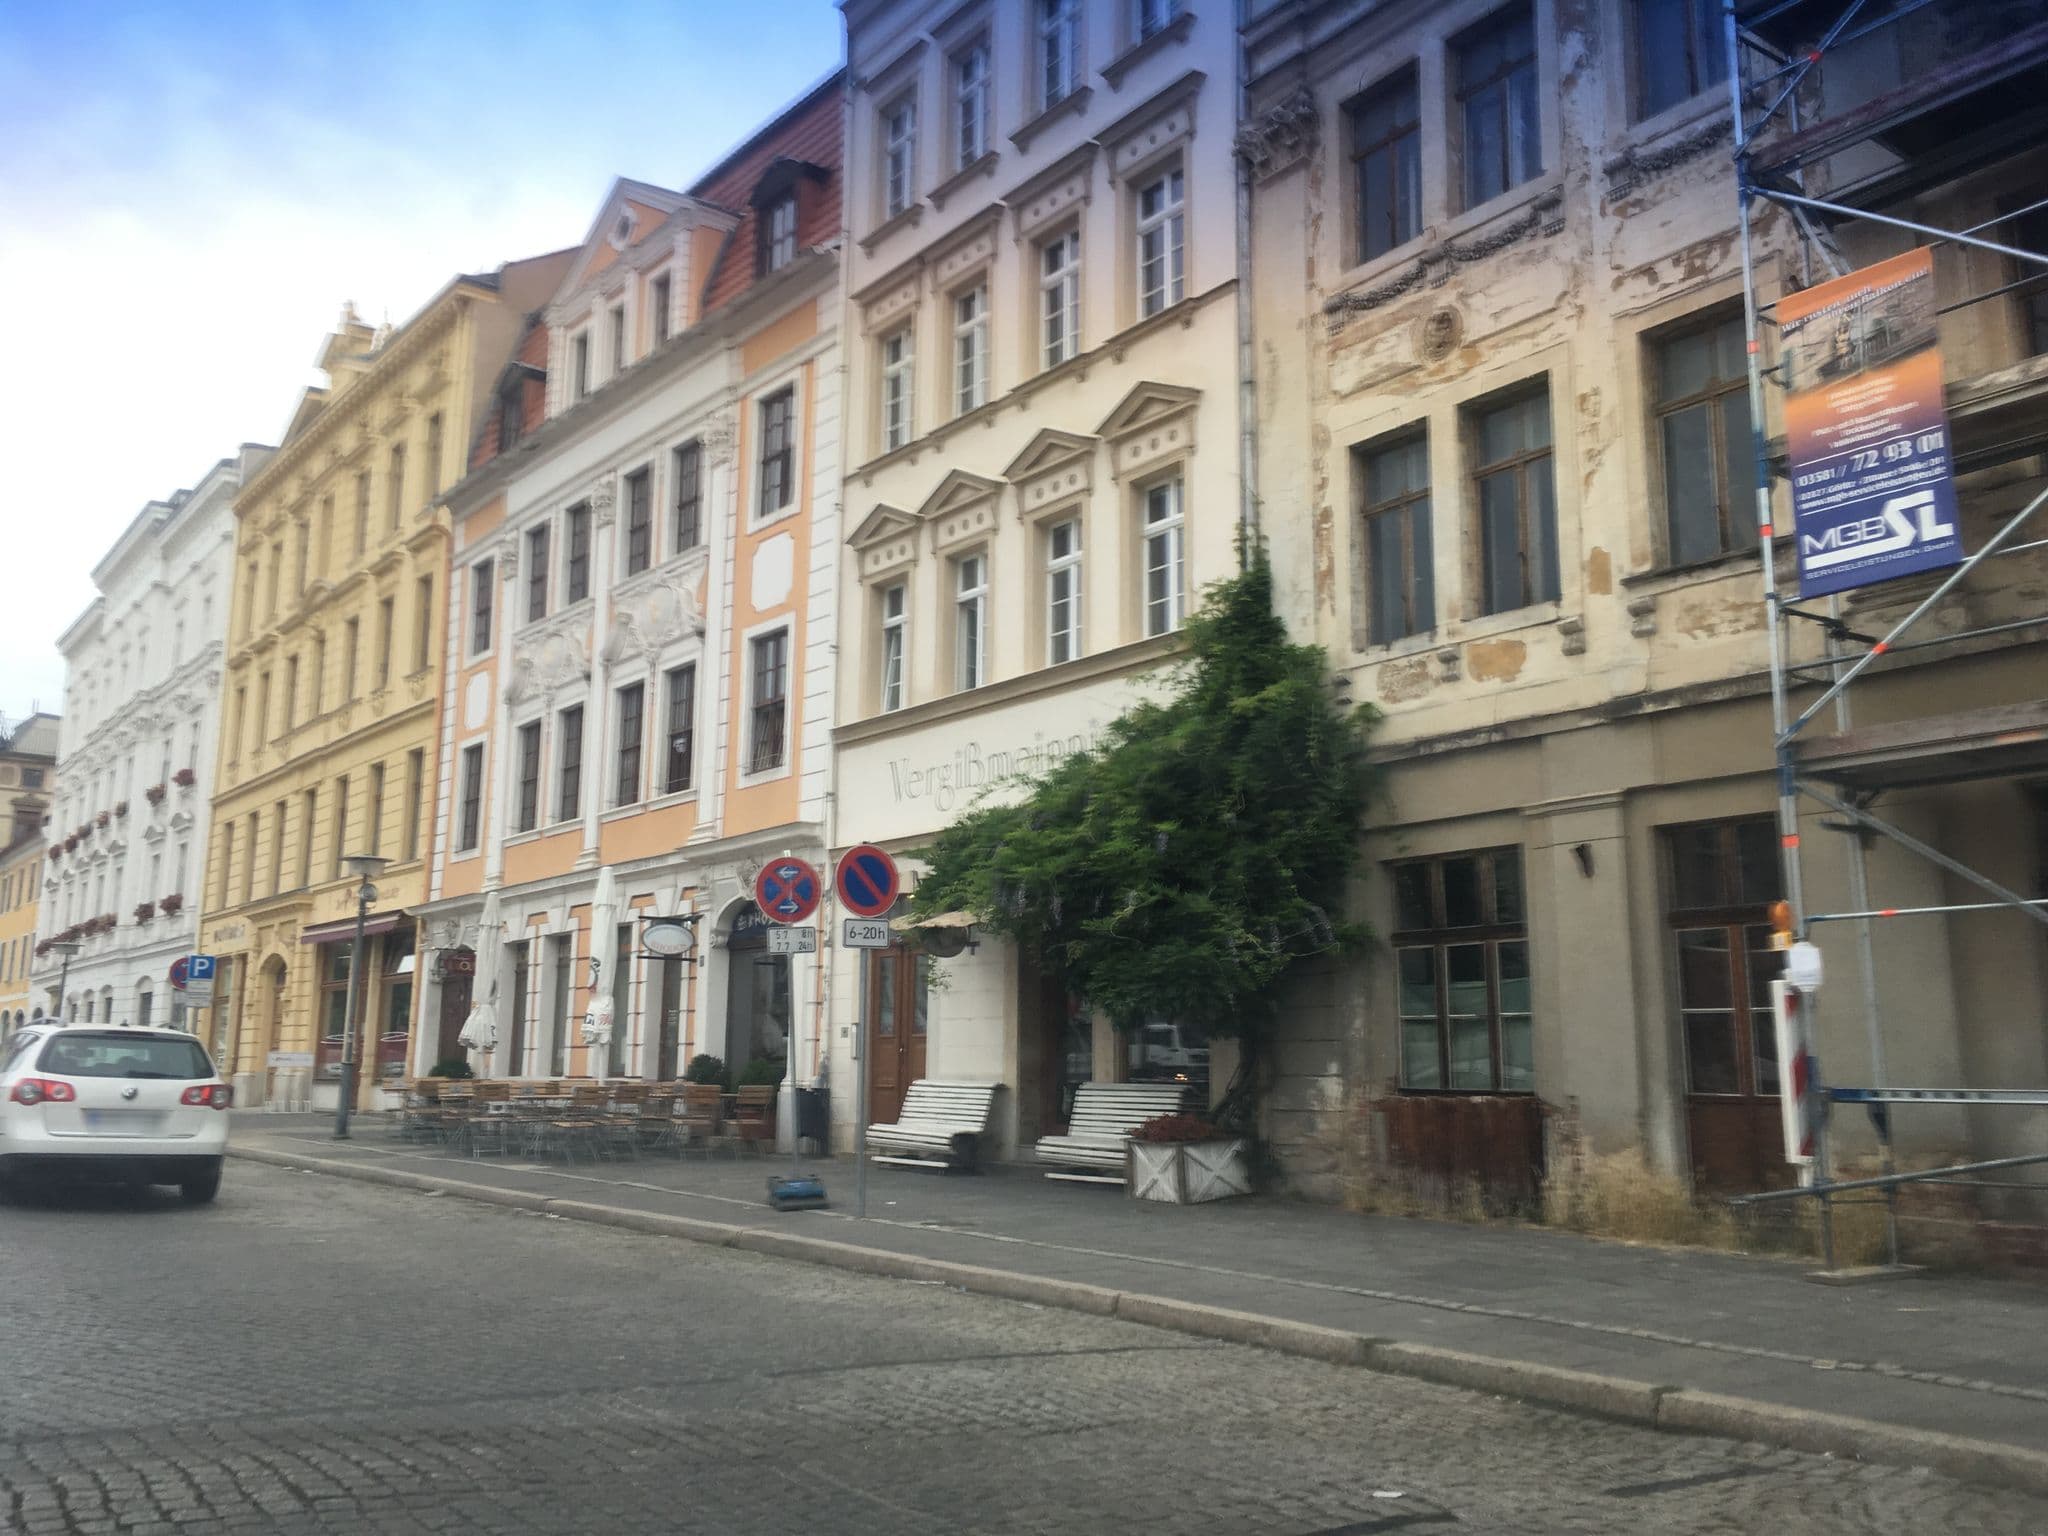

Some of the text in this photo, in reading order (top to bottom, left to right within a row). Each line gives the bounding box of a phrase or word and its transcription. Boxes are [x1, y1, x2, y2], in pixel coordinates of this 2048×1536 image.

[1849, 449, 1881, 472] 72
[1882, 440, 1913, 463] 93
[850, 926, 886, 940] 6-20h
